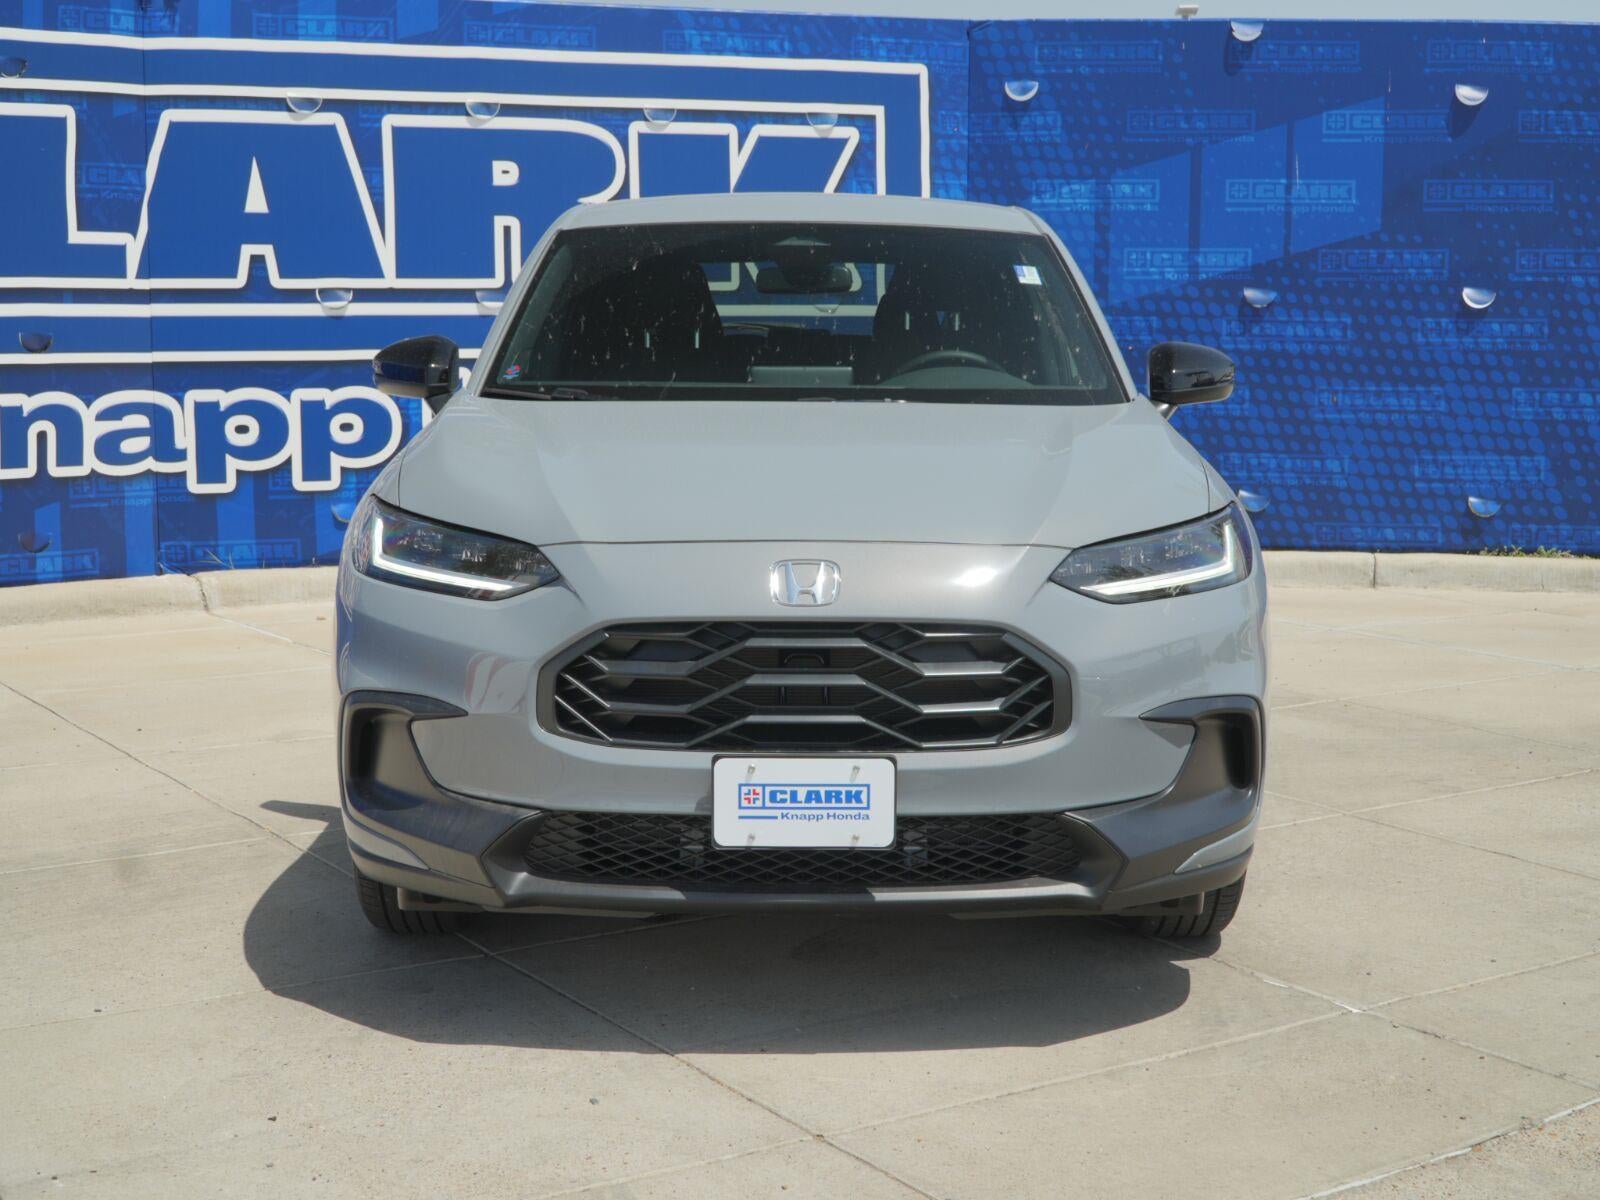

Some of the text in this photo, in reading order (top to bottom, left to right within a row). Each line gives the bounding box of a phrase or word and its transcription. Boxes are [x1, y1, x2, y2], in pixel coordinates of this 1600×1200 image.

[285, 18, 386, 38] CLARK
[493, 27, 591, 47] CLARK
[1155, 114, 1250, 130] CLARK
[1352, 114, 1448, 129] CLARK
[1061, 184, 1154, 199] CLARK
[1255, 184, 1350, 199] CLARK
[1453, 184, 1548, 199] CLARK
[1312, 203, 1356, 213] Honda
[1464, 203, 1553, 215] Knapp Honda
[1153, 253, 1246, 268] CLARK
[768, 789, 865, 805] CLARK
[780, 812, 870, 823] Knapp Honda
